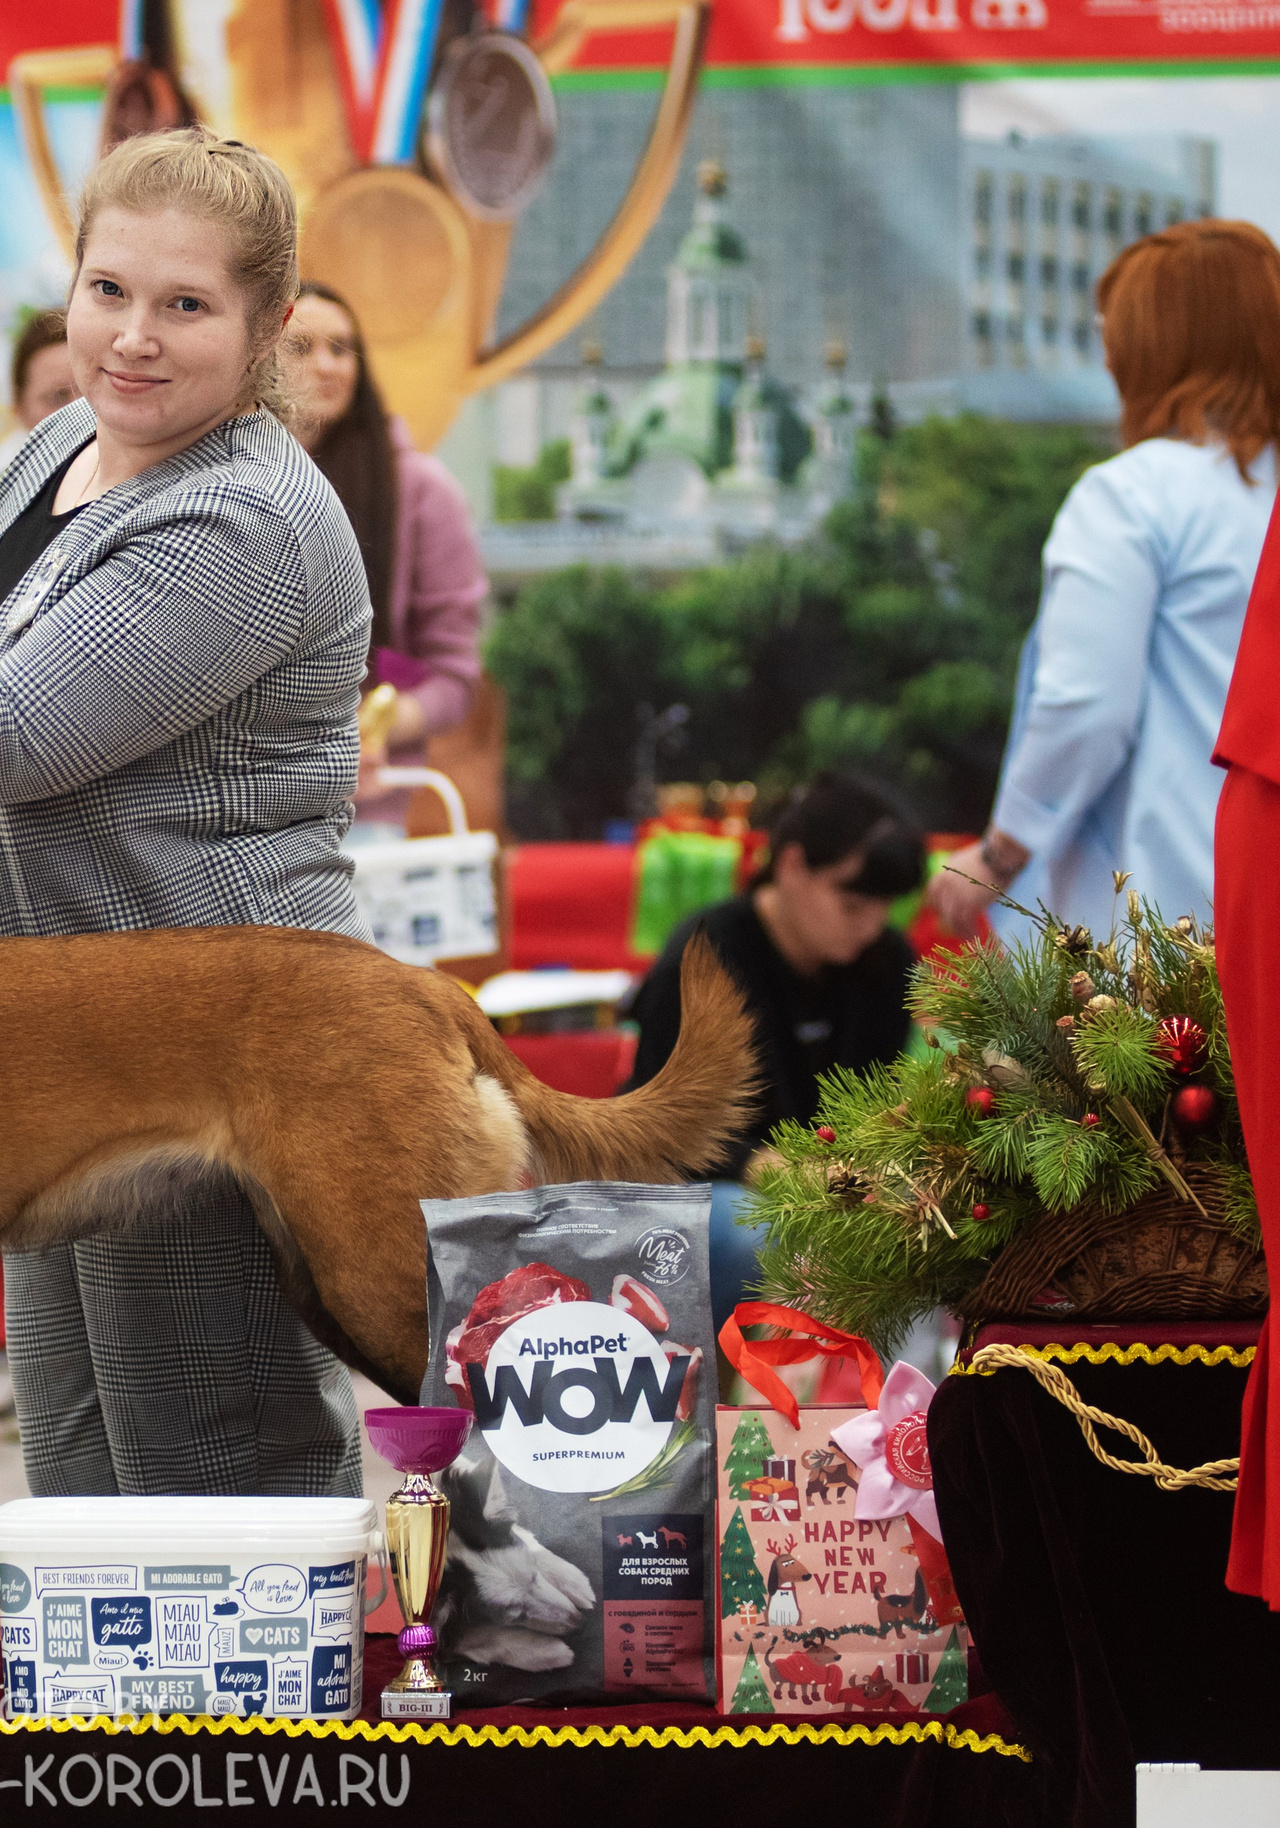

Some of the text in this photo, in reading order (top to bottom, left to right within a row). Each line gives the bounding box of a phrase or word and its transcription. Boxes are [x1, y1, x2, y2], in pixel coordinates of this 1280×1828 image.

[638, 1236, 685, 1264] Meat
[519, 1333, 627, 1360] AlphaPet
[466, 1355, 692, 1436] WOW
[532, 1450, 626, 1462] SUPERPREMIUM
[804, 1520, 892, 1543] HAPPY
[622, 1557, 688, 1567] ДЛЯ ВЗРОСЛЫХ
[824, 1546, 875, 1567] NEW
[42, 1573, 130, 1585] BEST FRIENDS FOREVER
[151, 1573, 223, 1584] MI ADORABLE GATO
[619, 1567, 690, 1577] СОБАК СРЕДНИХ
[250, 1580, 300, 1594] All you feed
[641, 1577, 673, 1586] ПОРОД
[813, 1571, 887, 1595] YEAR
[275, 1591, 293, 1603] love
[100, 1603, 118, 1615] Amo
[163, 1604, 200, 1622] MIAU
[614, 1609, 657, 1618] говядиной
[321, 1611, 345, 1624] HAPPY
[4, 1626, 31, 1645] CATS
[47, 1619, 83, 1640] MON
[101, 1615, 145, 1645] gatto
[164, 1623, 201, 1642] MIAU
[264, 1627, 300, 1645] CATS
[48, 1640, 83, 1658] CHAT
[222, 1631, 231, 1654] MAUZ
[165, 1643, 202, 1662] MIAU
[98, 1657, 123, 1665] Miau!
[334, 1653, 346, 1669] MI
[15, 1666, 29, 1676] AMO
[221, 1666, 262, 1690] happy
[463, 1668, 488, 1682] 2 кг
[131, 1681, 195, 1693] MY BEST
[278, 1680, 302, 1693] MON
[51, 1688, 106, 1703] HAPPY CAT
[132, 1694, 195, 1710] FRIEND
[278, 1694, 302, 1706] CHAT
[325, 1688, 348, 1706] GATO
[14, 1698, 34, 1709] GATTO
[399, 1703, 433, 1713] BIG-III
